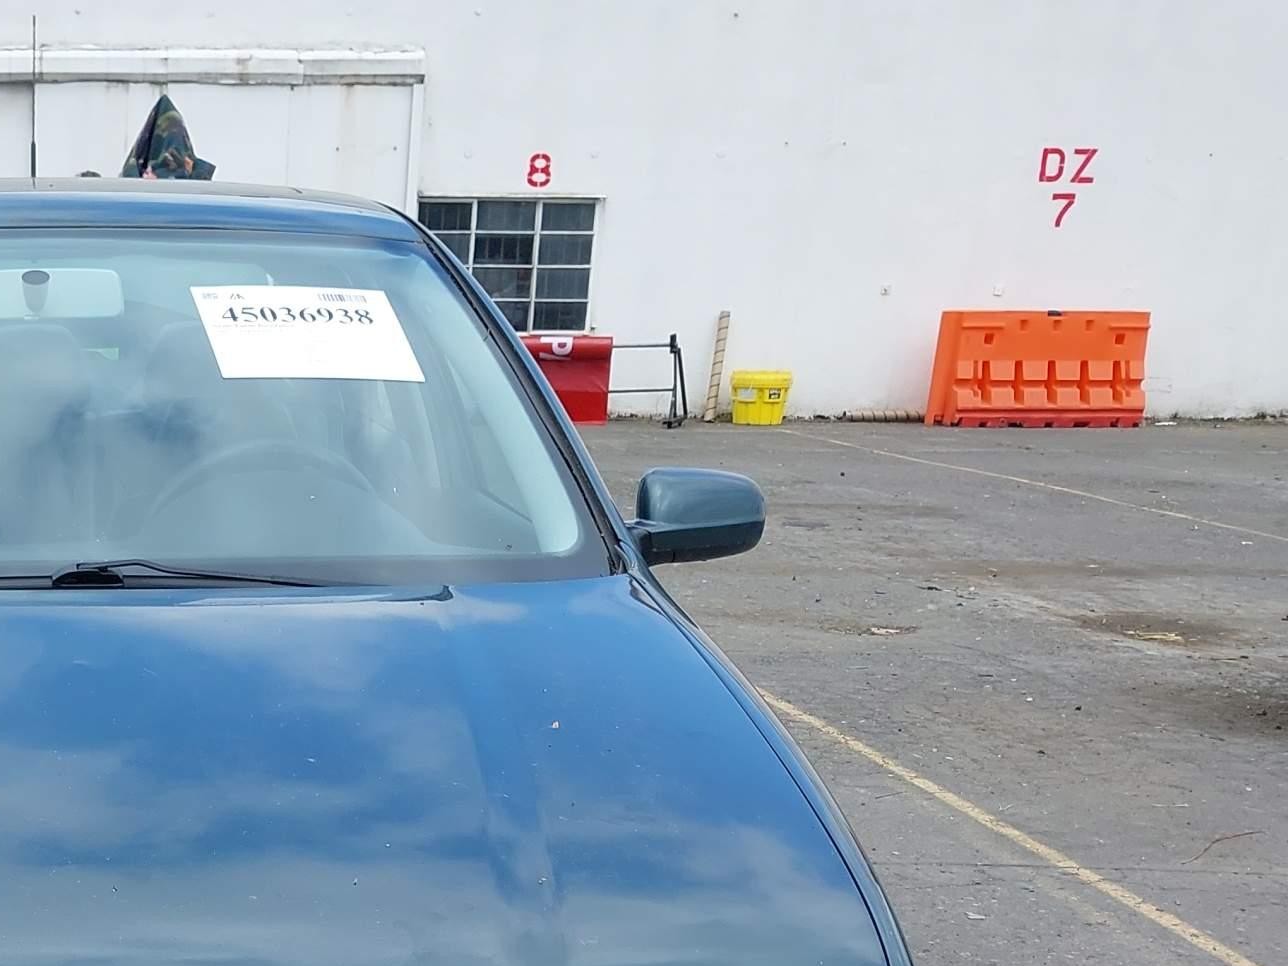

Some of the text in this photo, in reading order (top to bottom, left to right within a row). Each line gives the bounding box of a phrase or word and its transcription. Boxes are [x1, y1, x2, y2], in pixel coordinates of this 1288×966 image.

[527, 153, 551, 187] 8
[1039, 147, 1098, 183] DZ
[1052, 193, 1076, 227] 7
[222, 306, 374, 325] 45036938
